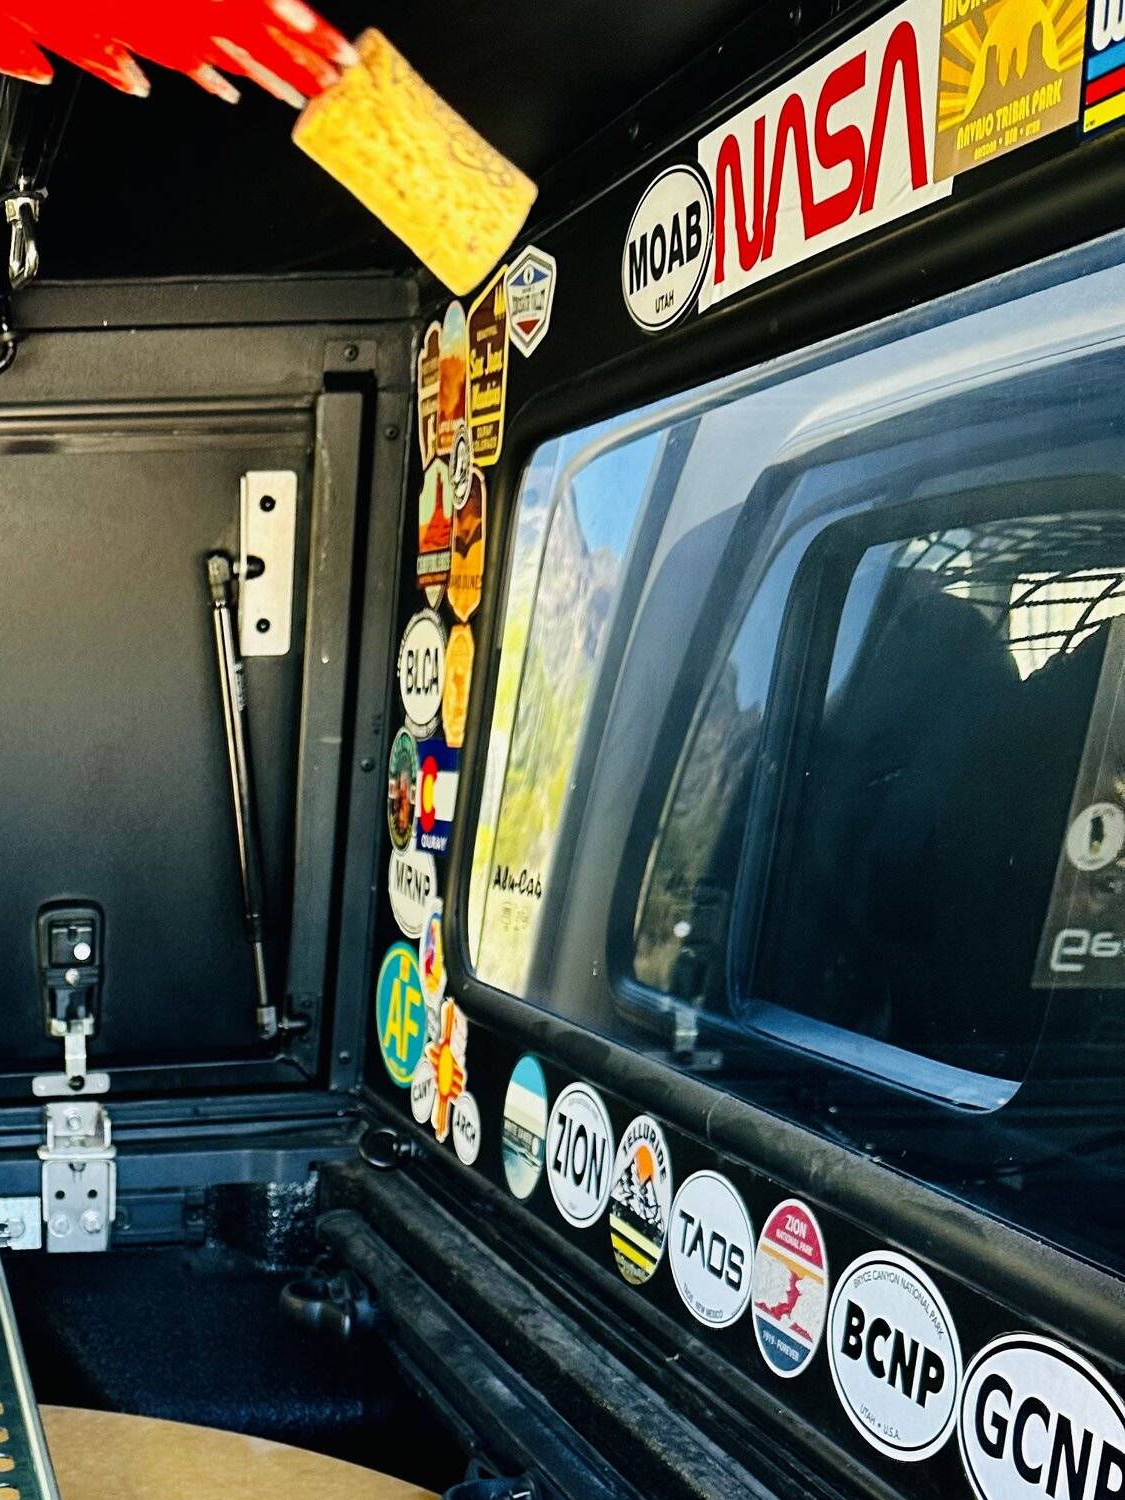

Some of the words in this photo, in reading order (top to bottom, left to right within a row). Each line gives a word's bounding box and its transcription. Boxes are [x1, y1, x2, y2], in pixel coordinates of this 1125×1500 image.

[995, 94, 1030, 132] TRIBAL
[1031, 79, 1063, 115] PARK
[713, 20, 929, 286] NASA
[628, 200, 702, 296] MOAB
[655, 289, 675, 313] UTAH
[405, 647, 440, 695] BLCA
[552, 1111, 606, 1201] ZION
[622, 1123, 667, 1185] TELLURIDE
[678, 1208, 745, 1292] TAOS
[776, 1230, 800, 1252] NATIONAL
[800, 1241, 815, 1257] PARK
[785, 1214, 808, 1240] ZION
[853, 1271, 872, 1289] BRYCE
[872, 1270, 900, 1286] CANYON
[900, 1276, 930, 1315] NATIONAL
[929, 1311, 946, 1341] PARK
[840, 1298, 945, 1409] BCNP
[859, 1403, 876, 1427] UTAH
